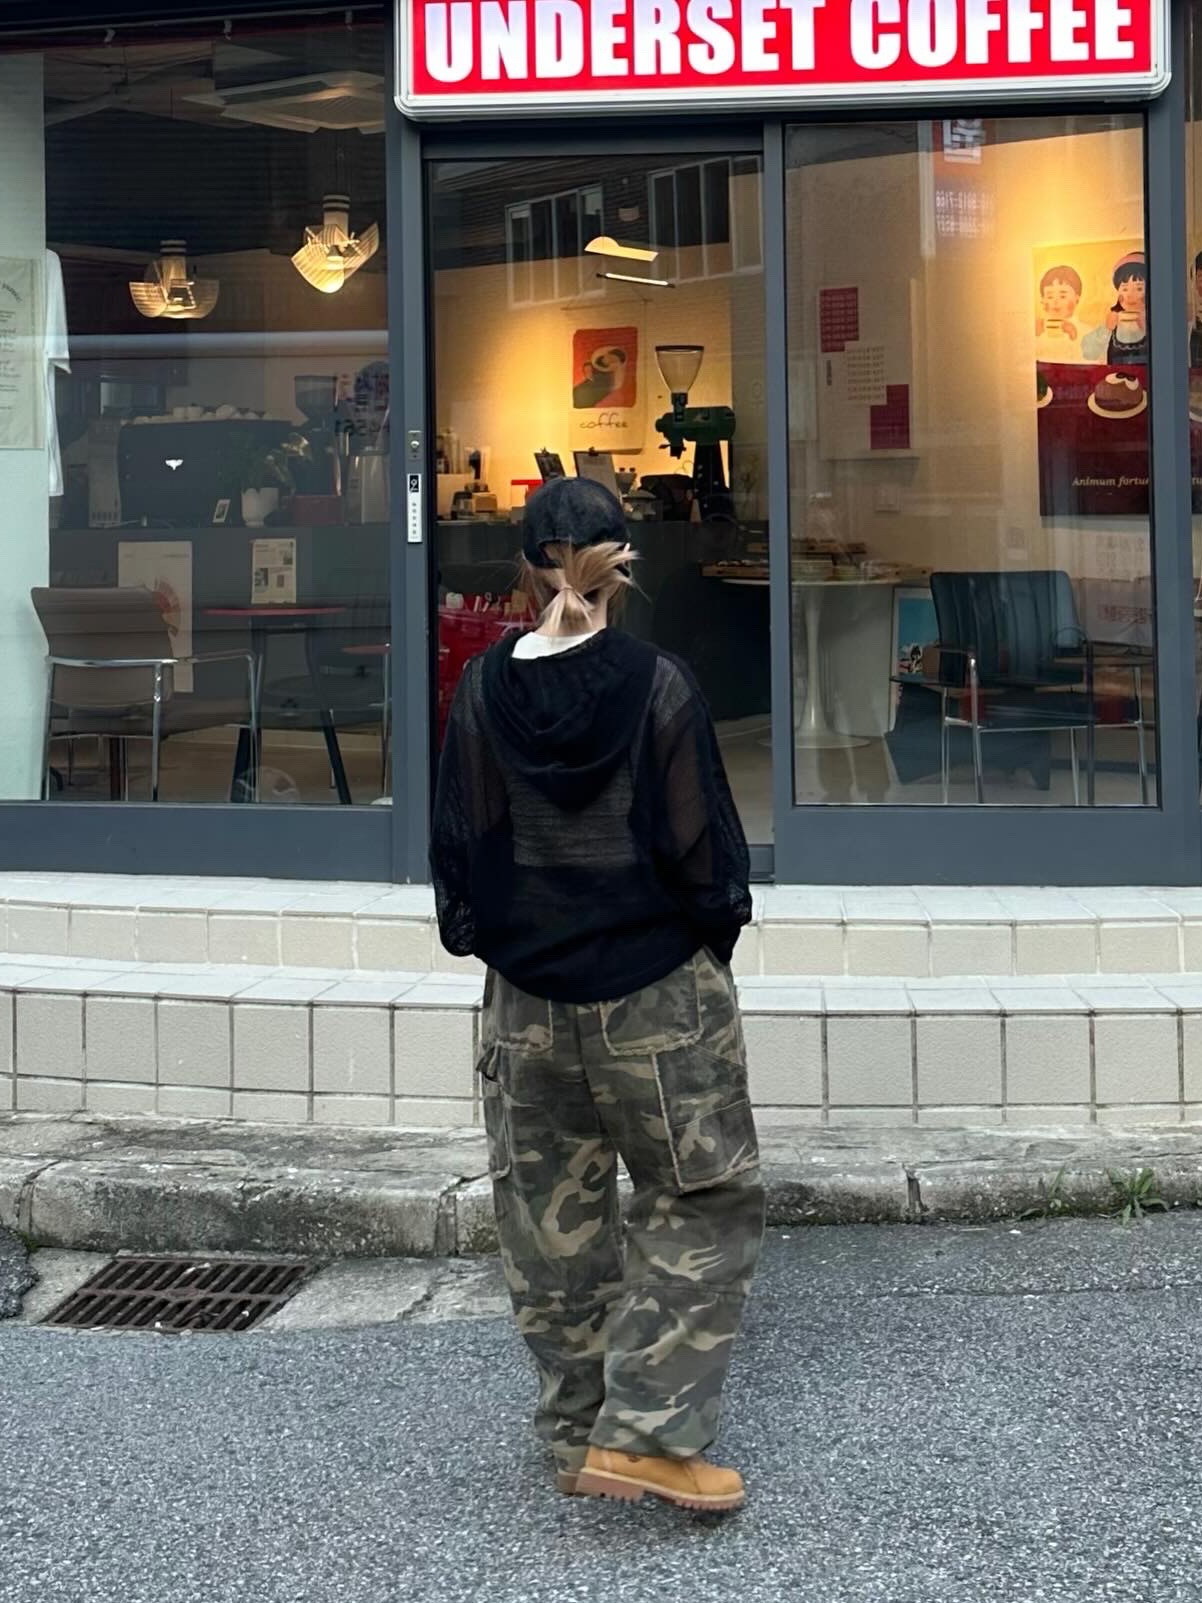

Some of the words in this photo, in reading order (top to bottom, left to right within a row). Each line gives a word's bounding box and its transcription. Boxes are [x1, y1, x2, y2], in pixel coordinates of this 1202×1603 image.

[424, 0, 825, 83] UNDERSET
[850, 0, 1135, 70] COFFEE
[579, 412, 629, 429] coffee
